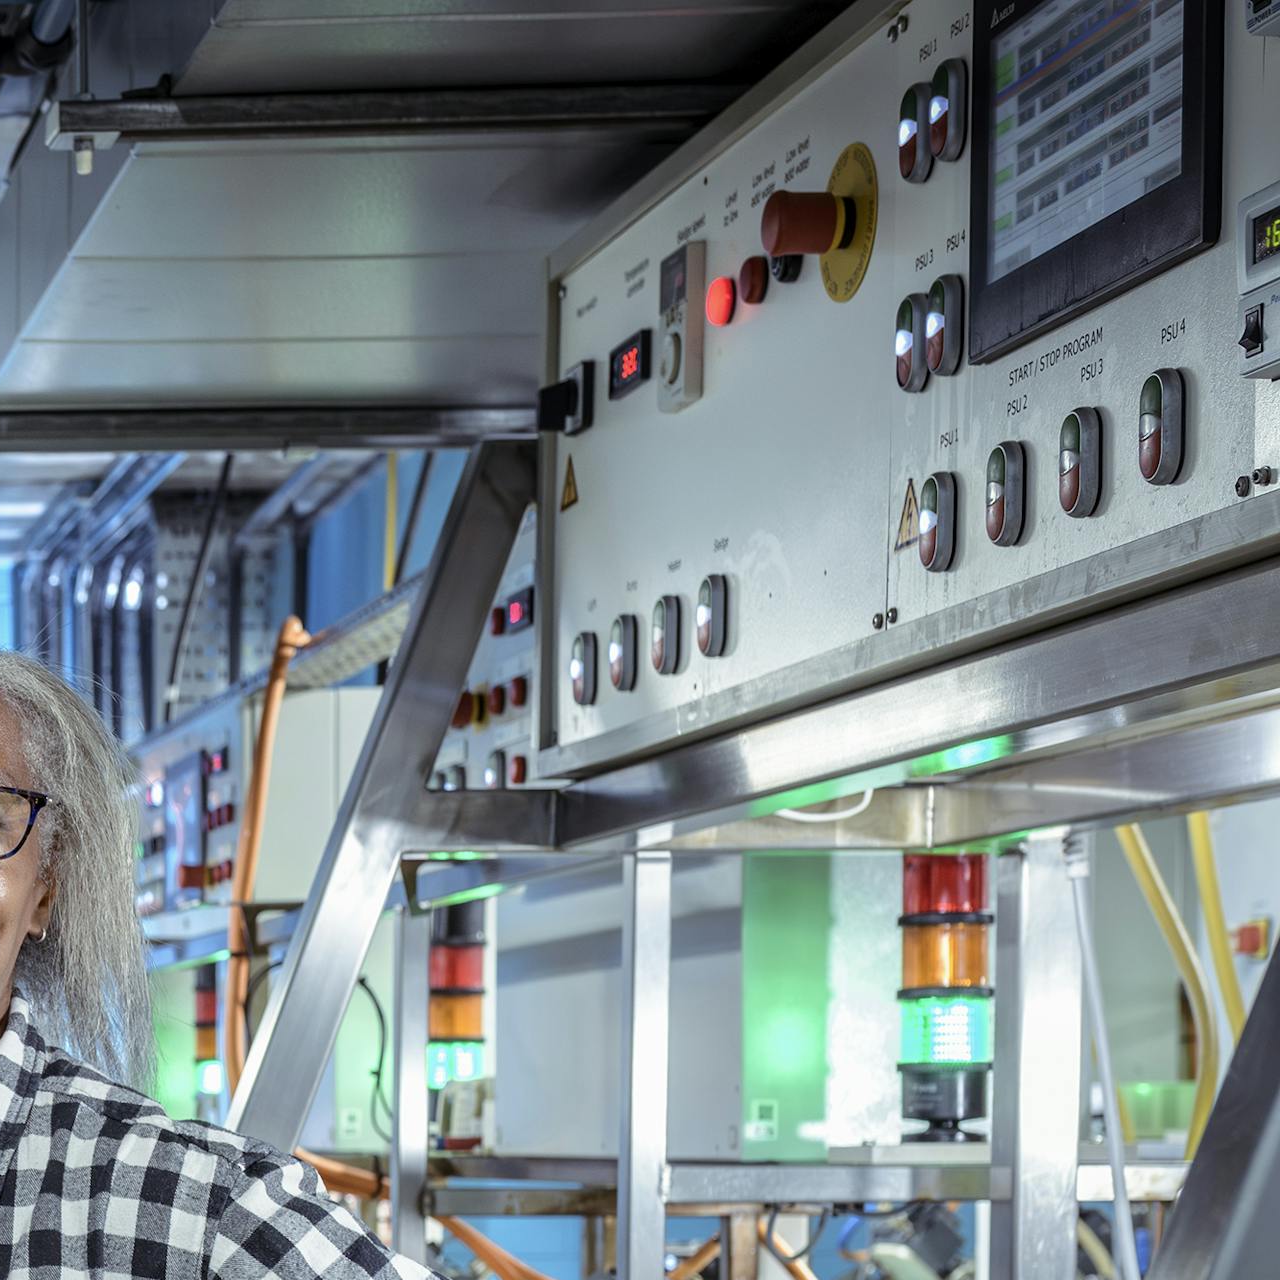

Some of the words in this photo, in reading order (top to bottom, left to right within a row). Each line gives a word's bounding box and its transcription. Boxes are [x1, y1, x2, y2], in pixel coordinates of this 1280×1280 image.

[951, 16, 964, 40] PSU
[920, 41, 932, 63] PSU
[946, 232, 960, 255] PSU
[915, 251, 929, 272] PSU
[1160, 323, 1179, 345] PSU
[1179, 318, 1187, 335] 4
[1008, 361, 1034, 387] START
[1040, 348, 1061, 373] STOP
[1062, 326, 1104, 361] PROGRAM
[1080, 364, 1097, 382] PSU
[1097, 358, 1104, 375] 3
[1006, 399, 1022, 418] PSU
[1022, 394, 1028, 411] 2
[939, 431, 954, 448] PSU
